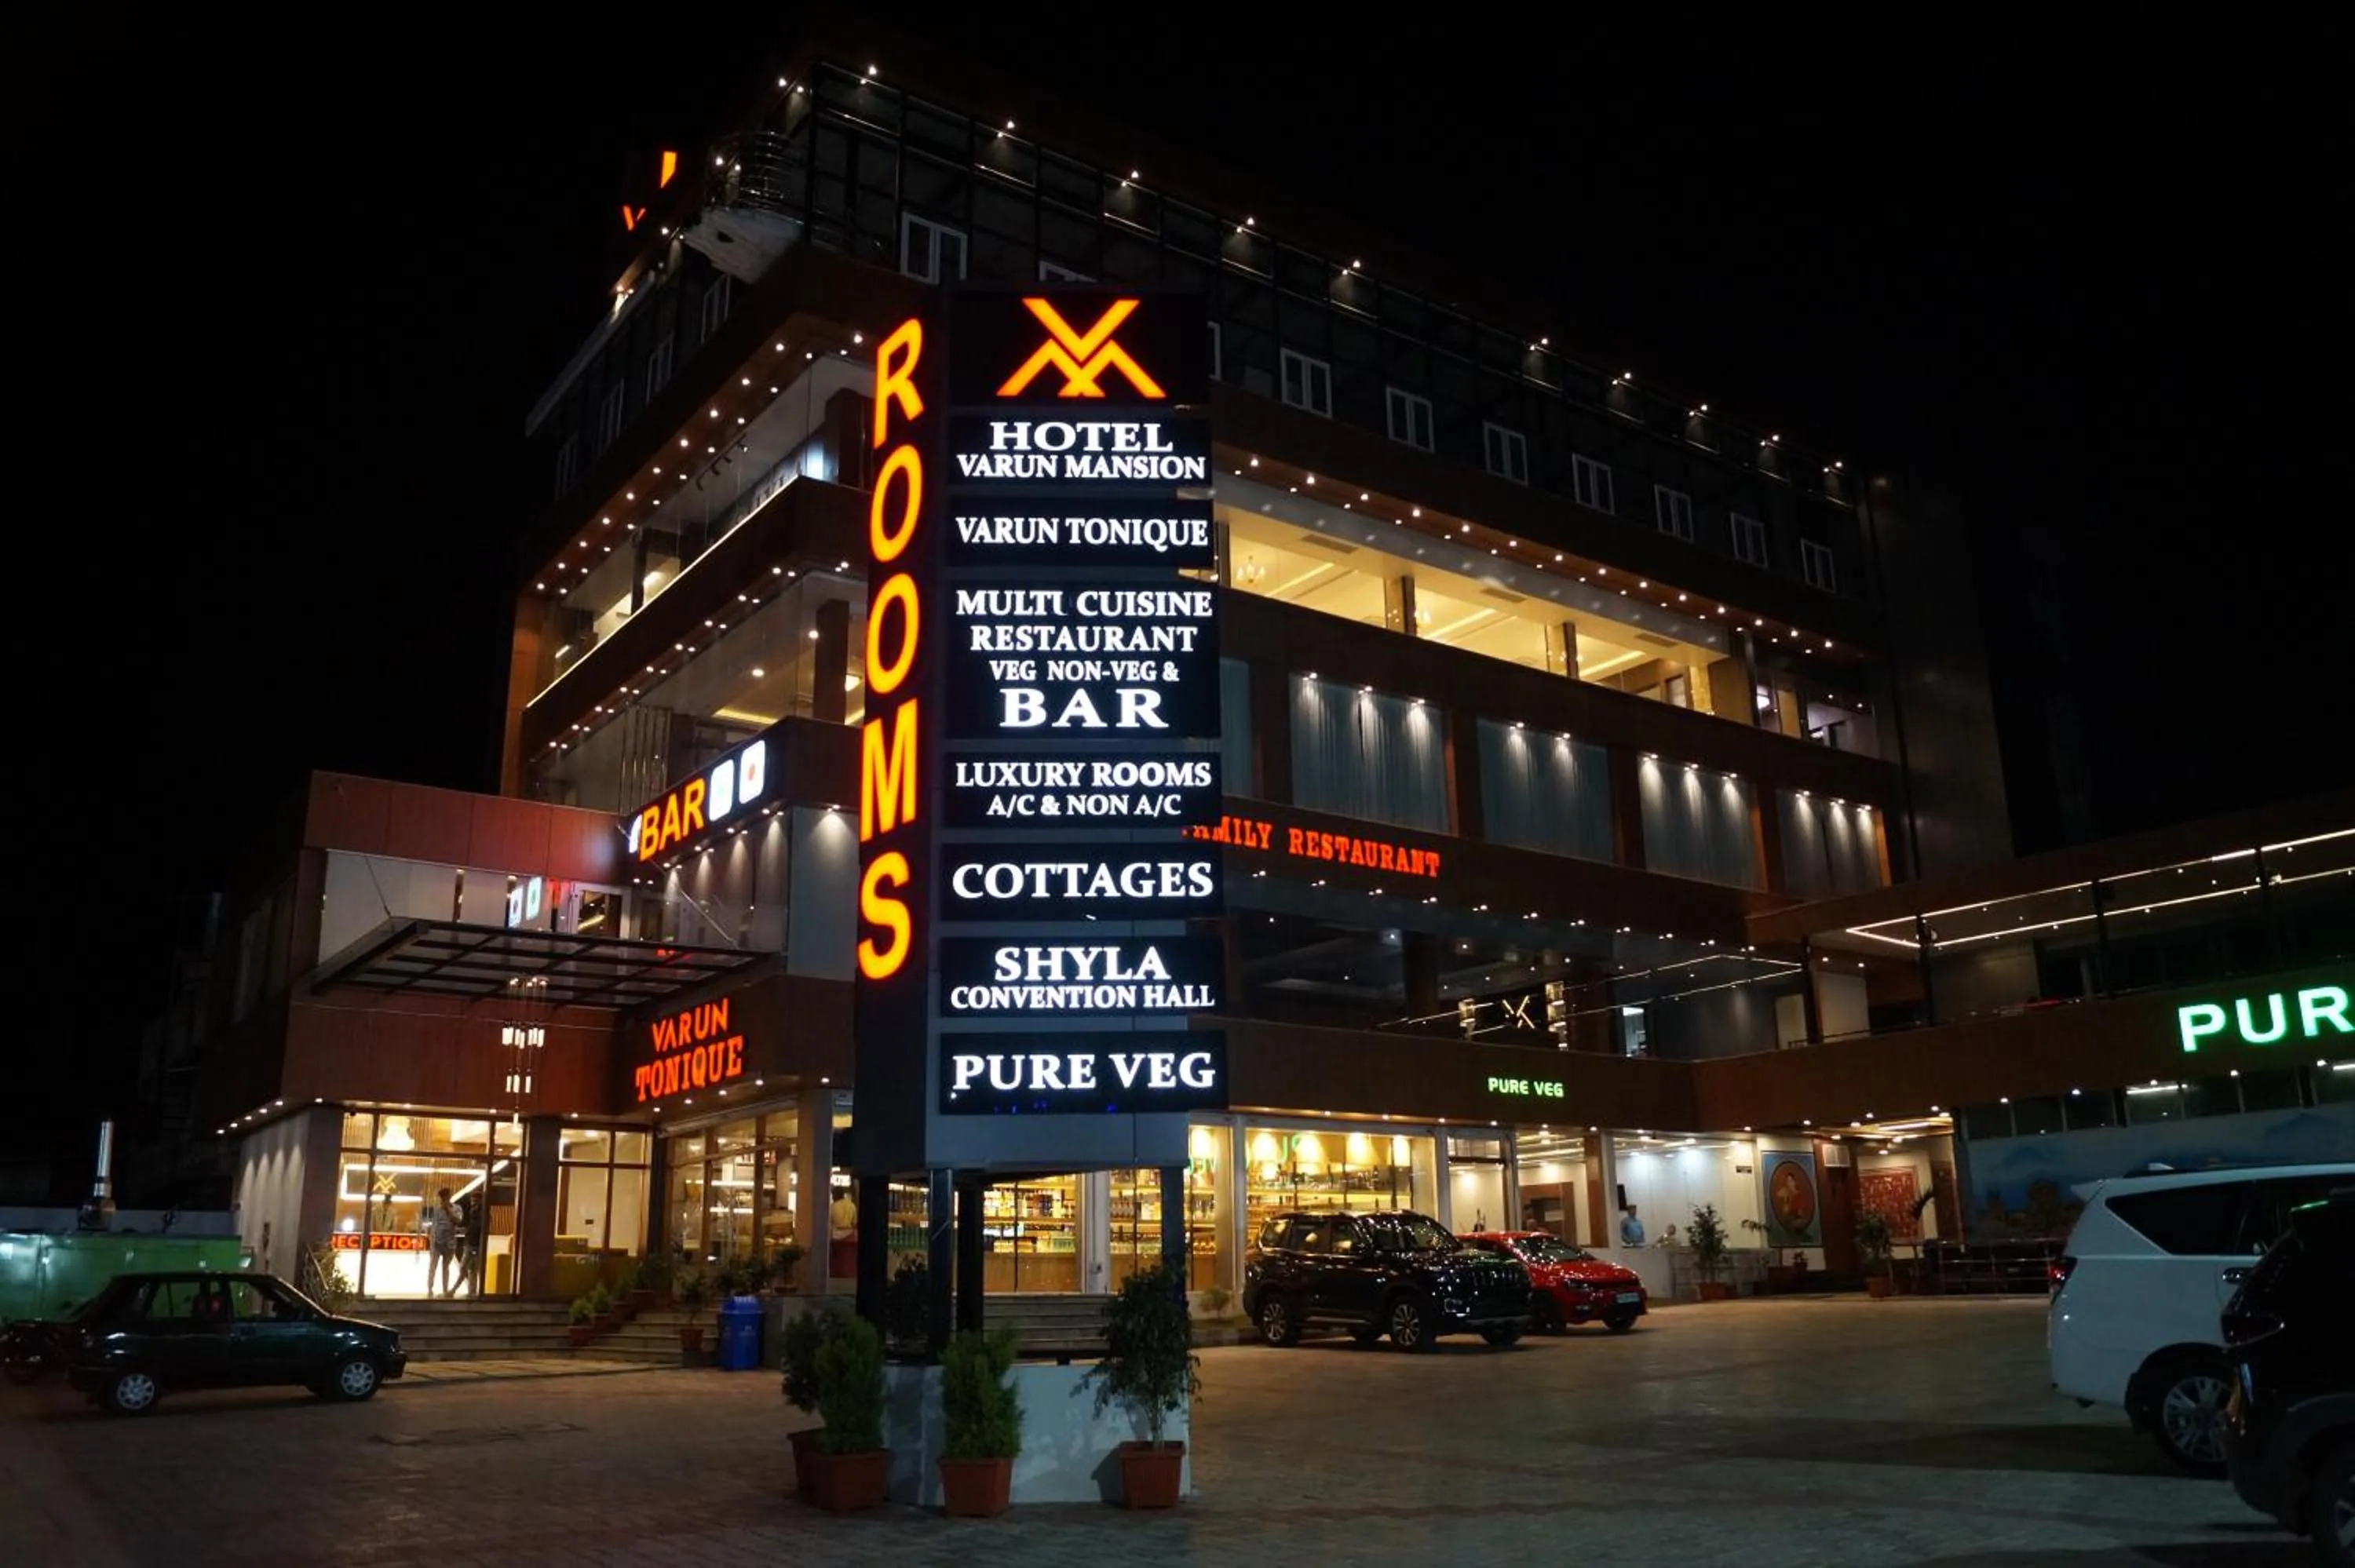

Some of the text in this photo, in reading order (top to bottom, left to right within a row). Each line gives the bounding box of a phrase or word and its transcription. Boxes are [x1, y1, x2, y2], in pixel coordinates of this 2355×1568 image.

[989, 421, 1174, 452] HOTEL
[956, 454, 1206, 480] VARUN MANSION
[955, 516, 1209, 552] VARUN TONIQUE
[1076, 590, 1213, 617] CUISINE
[857, 318, 924, 980] ROOMS
[969, 625, 1198, 652] RESTAURANT
[988, 659, 1180, 682] VEG NON-VEG &
[999, 687, 1169, 728] BAR
[955, 761, 1212, 787] LUXURY ROOMS
[640, 778, 706, 861] BAR
[986, 793, 1182, 818] A/C & NON A/C
[1288, 828, 1440, 877] RESTAURANT
[952, 862, 1214, 899] COTTAGES
[995, 946, 1172, 982] SHYLA
[951, 984, 1215, 1009] CONVENTION HALL
[652, 997, 728, 1052] VARUN
[2178, 986, 2355, 1052] PUR
[636, 1035, 743, 1102] TONIQUE
[952, 1052, 1216, 1090] PURE VEG
[1488, 1077, 1565, 1098] PURE VEG
[331, 1233, 425, 1249] ECPTION
